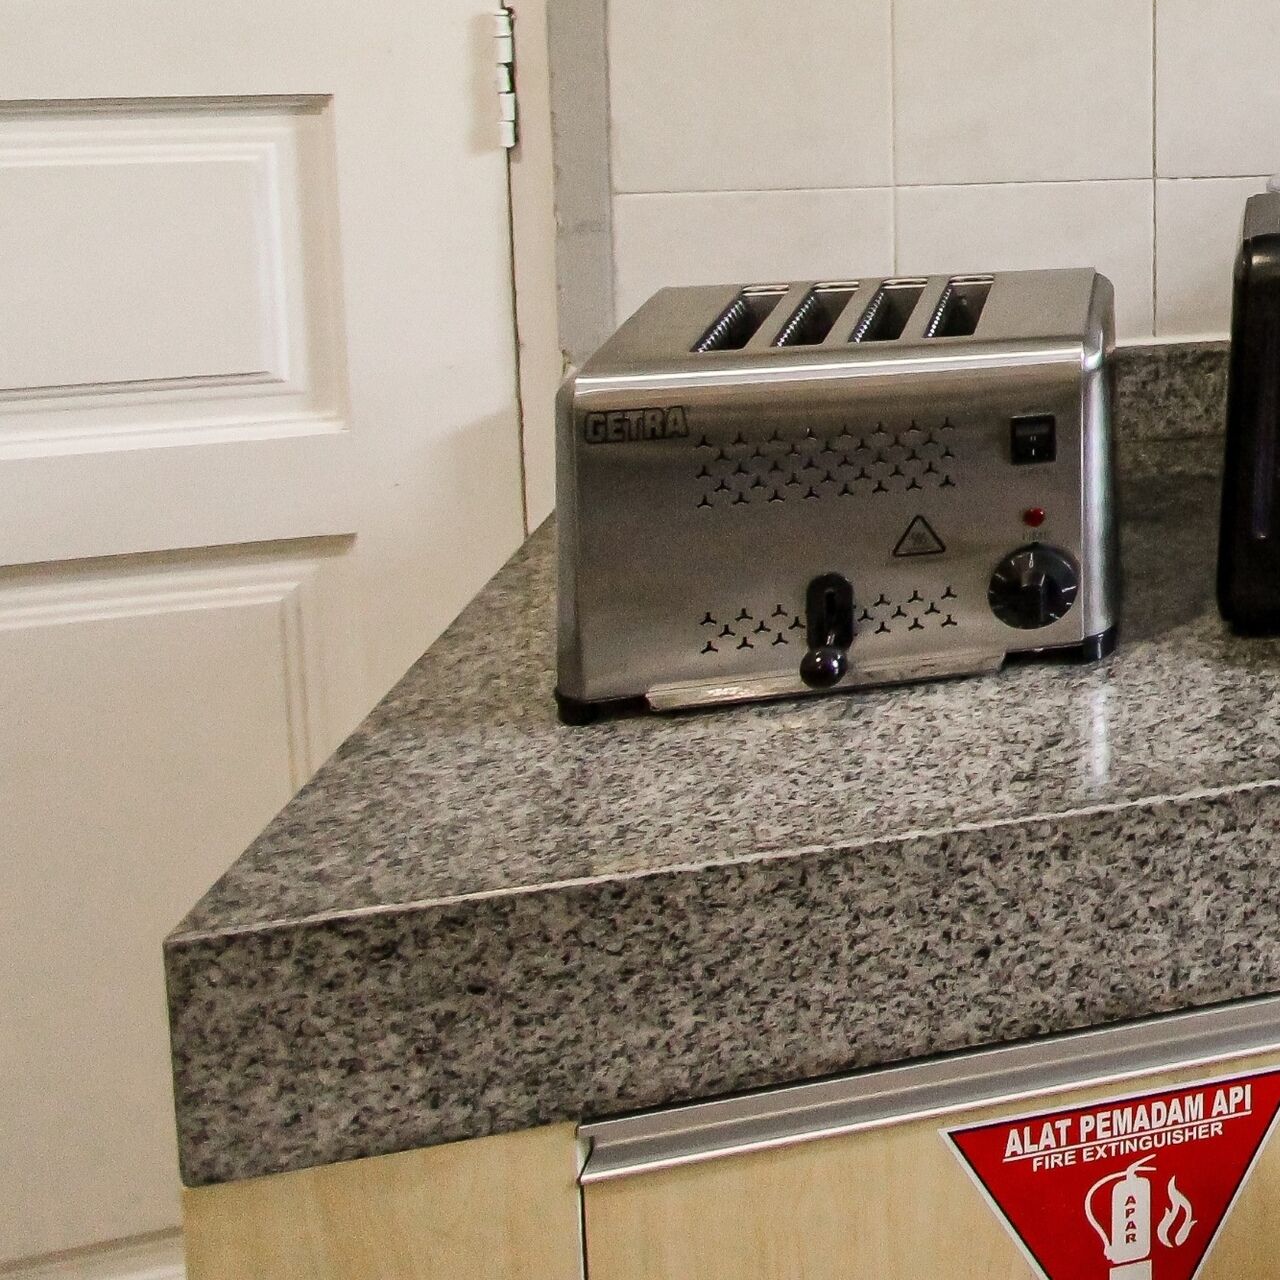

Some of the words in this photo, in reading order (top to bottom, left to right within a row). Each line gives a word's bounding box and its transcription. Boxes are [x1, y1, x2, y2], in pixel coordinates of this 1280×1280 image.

[584, 405, 689, 445] GETRA
[1004, 1118, 1072, 1158] ALAT
[1079, 1093, 1204, 1142] PEMADAM
[1211, 1084, 1252, 1117] API
[1032, 1150, 1077, 1172] FIRE
[1082, 1122, 1223, 1162] EXTINGUISHER
[1125, 1195, 1137, 1245] APAR
